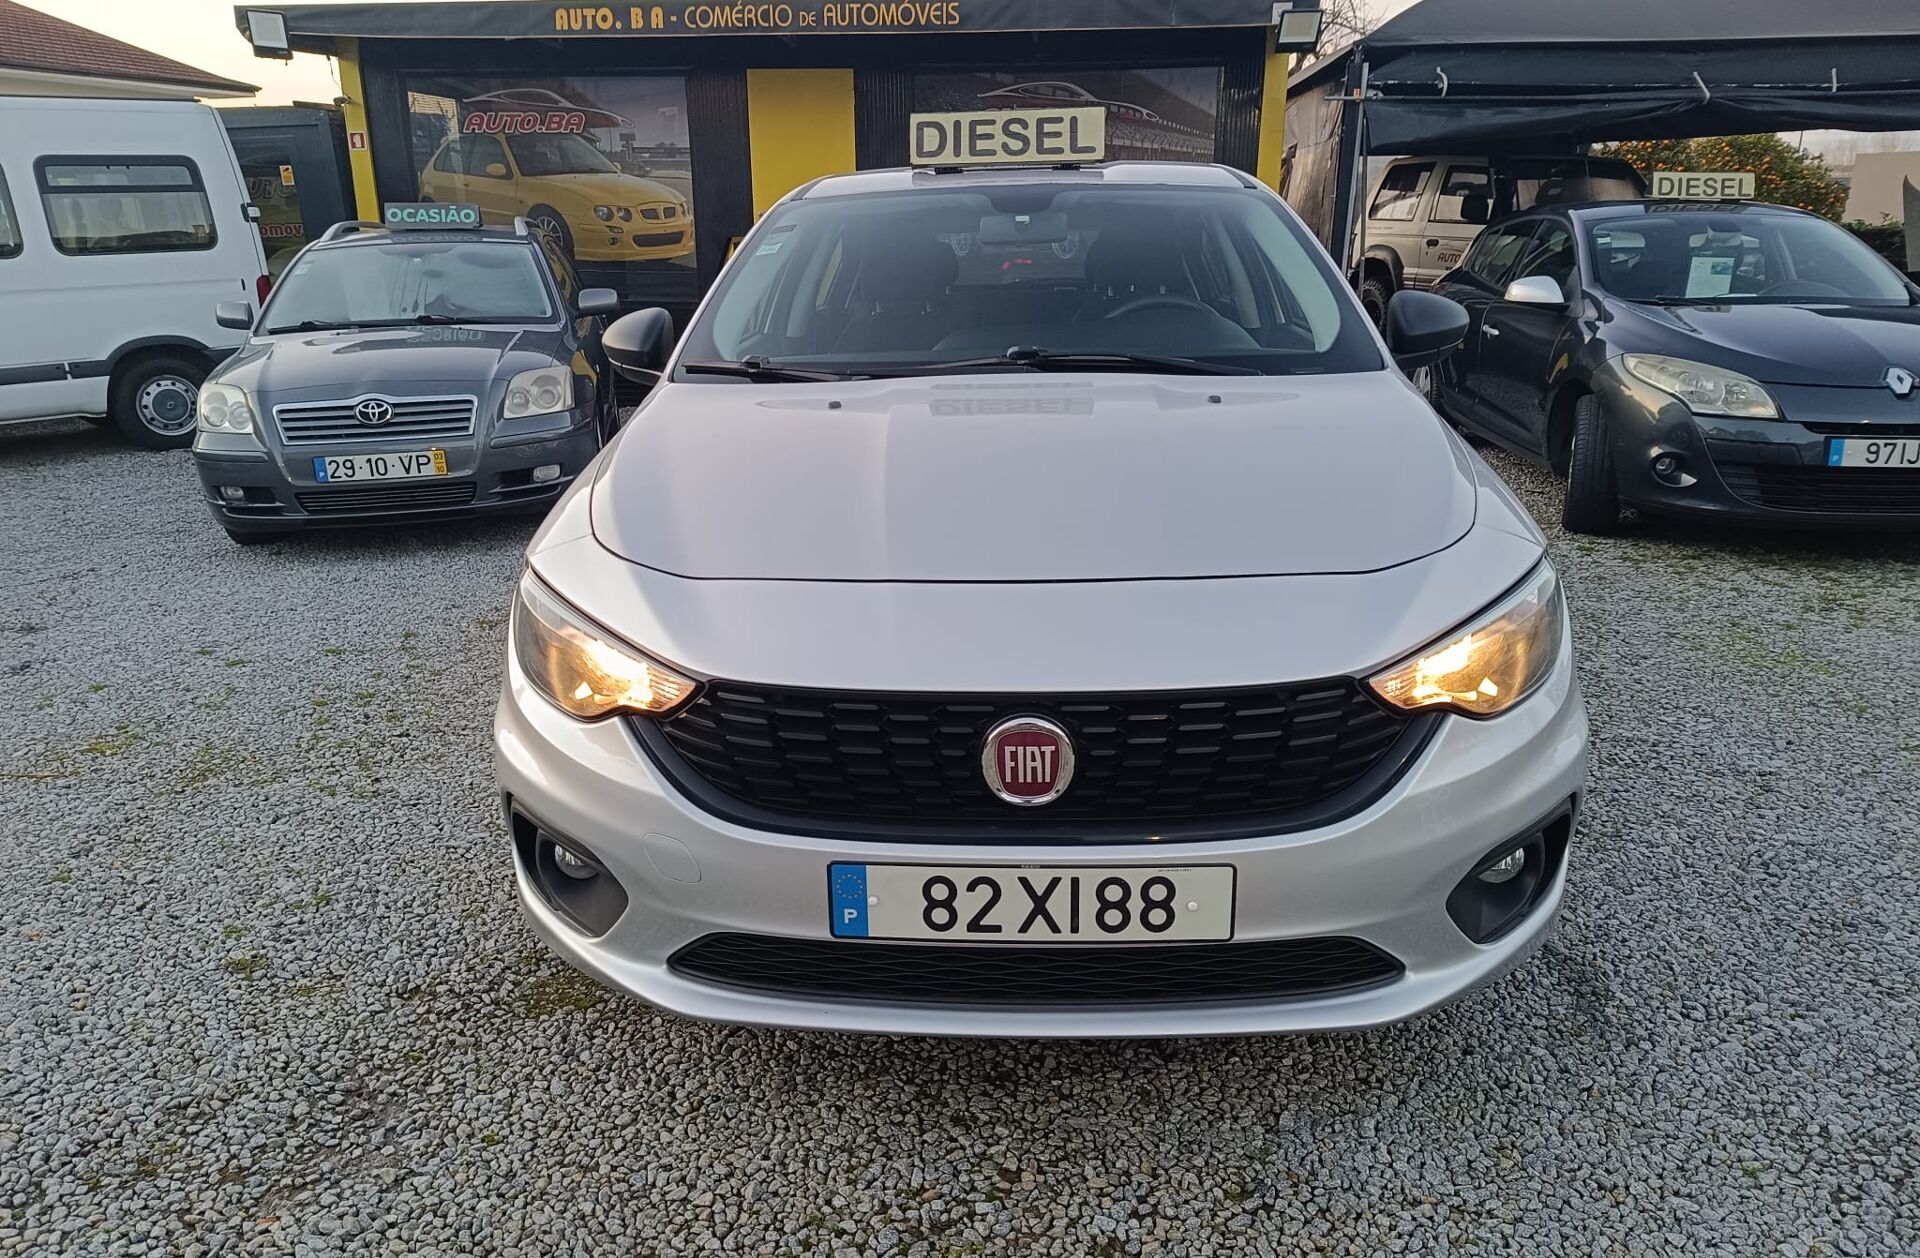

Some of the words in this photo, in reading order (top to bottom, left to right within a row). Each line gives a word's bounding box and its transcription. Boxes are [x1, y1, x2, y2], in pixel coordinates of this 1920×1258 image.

[555, 7, 623, 31] AUTO.
[684, 1, 793, 29] COMÉRCIO
[823, 0, 961, 27] AUTOMÓVEIS
[462, 111, 586, 134] AUTO.BA
[915, 115, 1098, 159] DIESEL
[1657, 176, 1753, 198] DIESEL
[386, 205, 476, 224] OCASIÃO
[1004, 745, 1056, 783] FIAT
[843, 908, 858, 924] P
